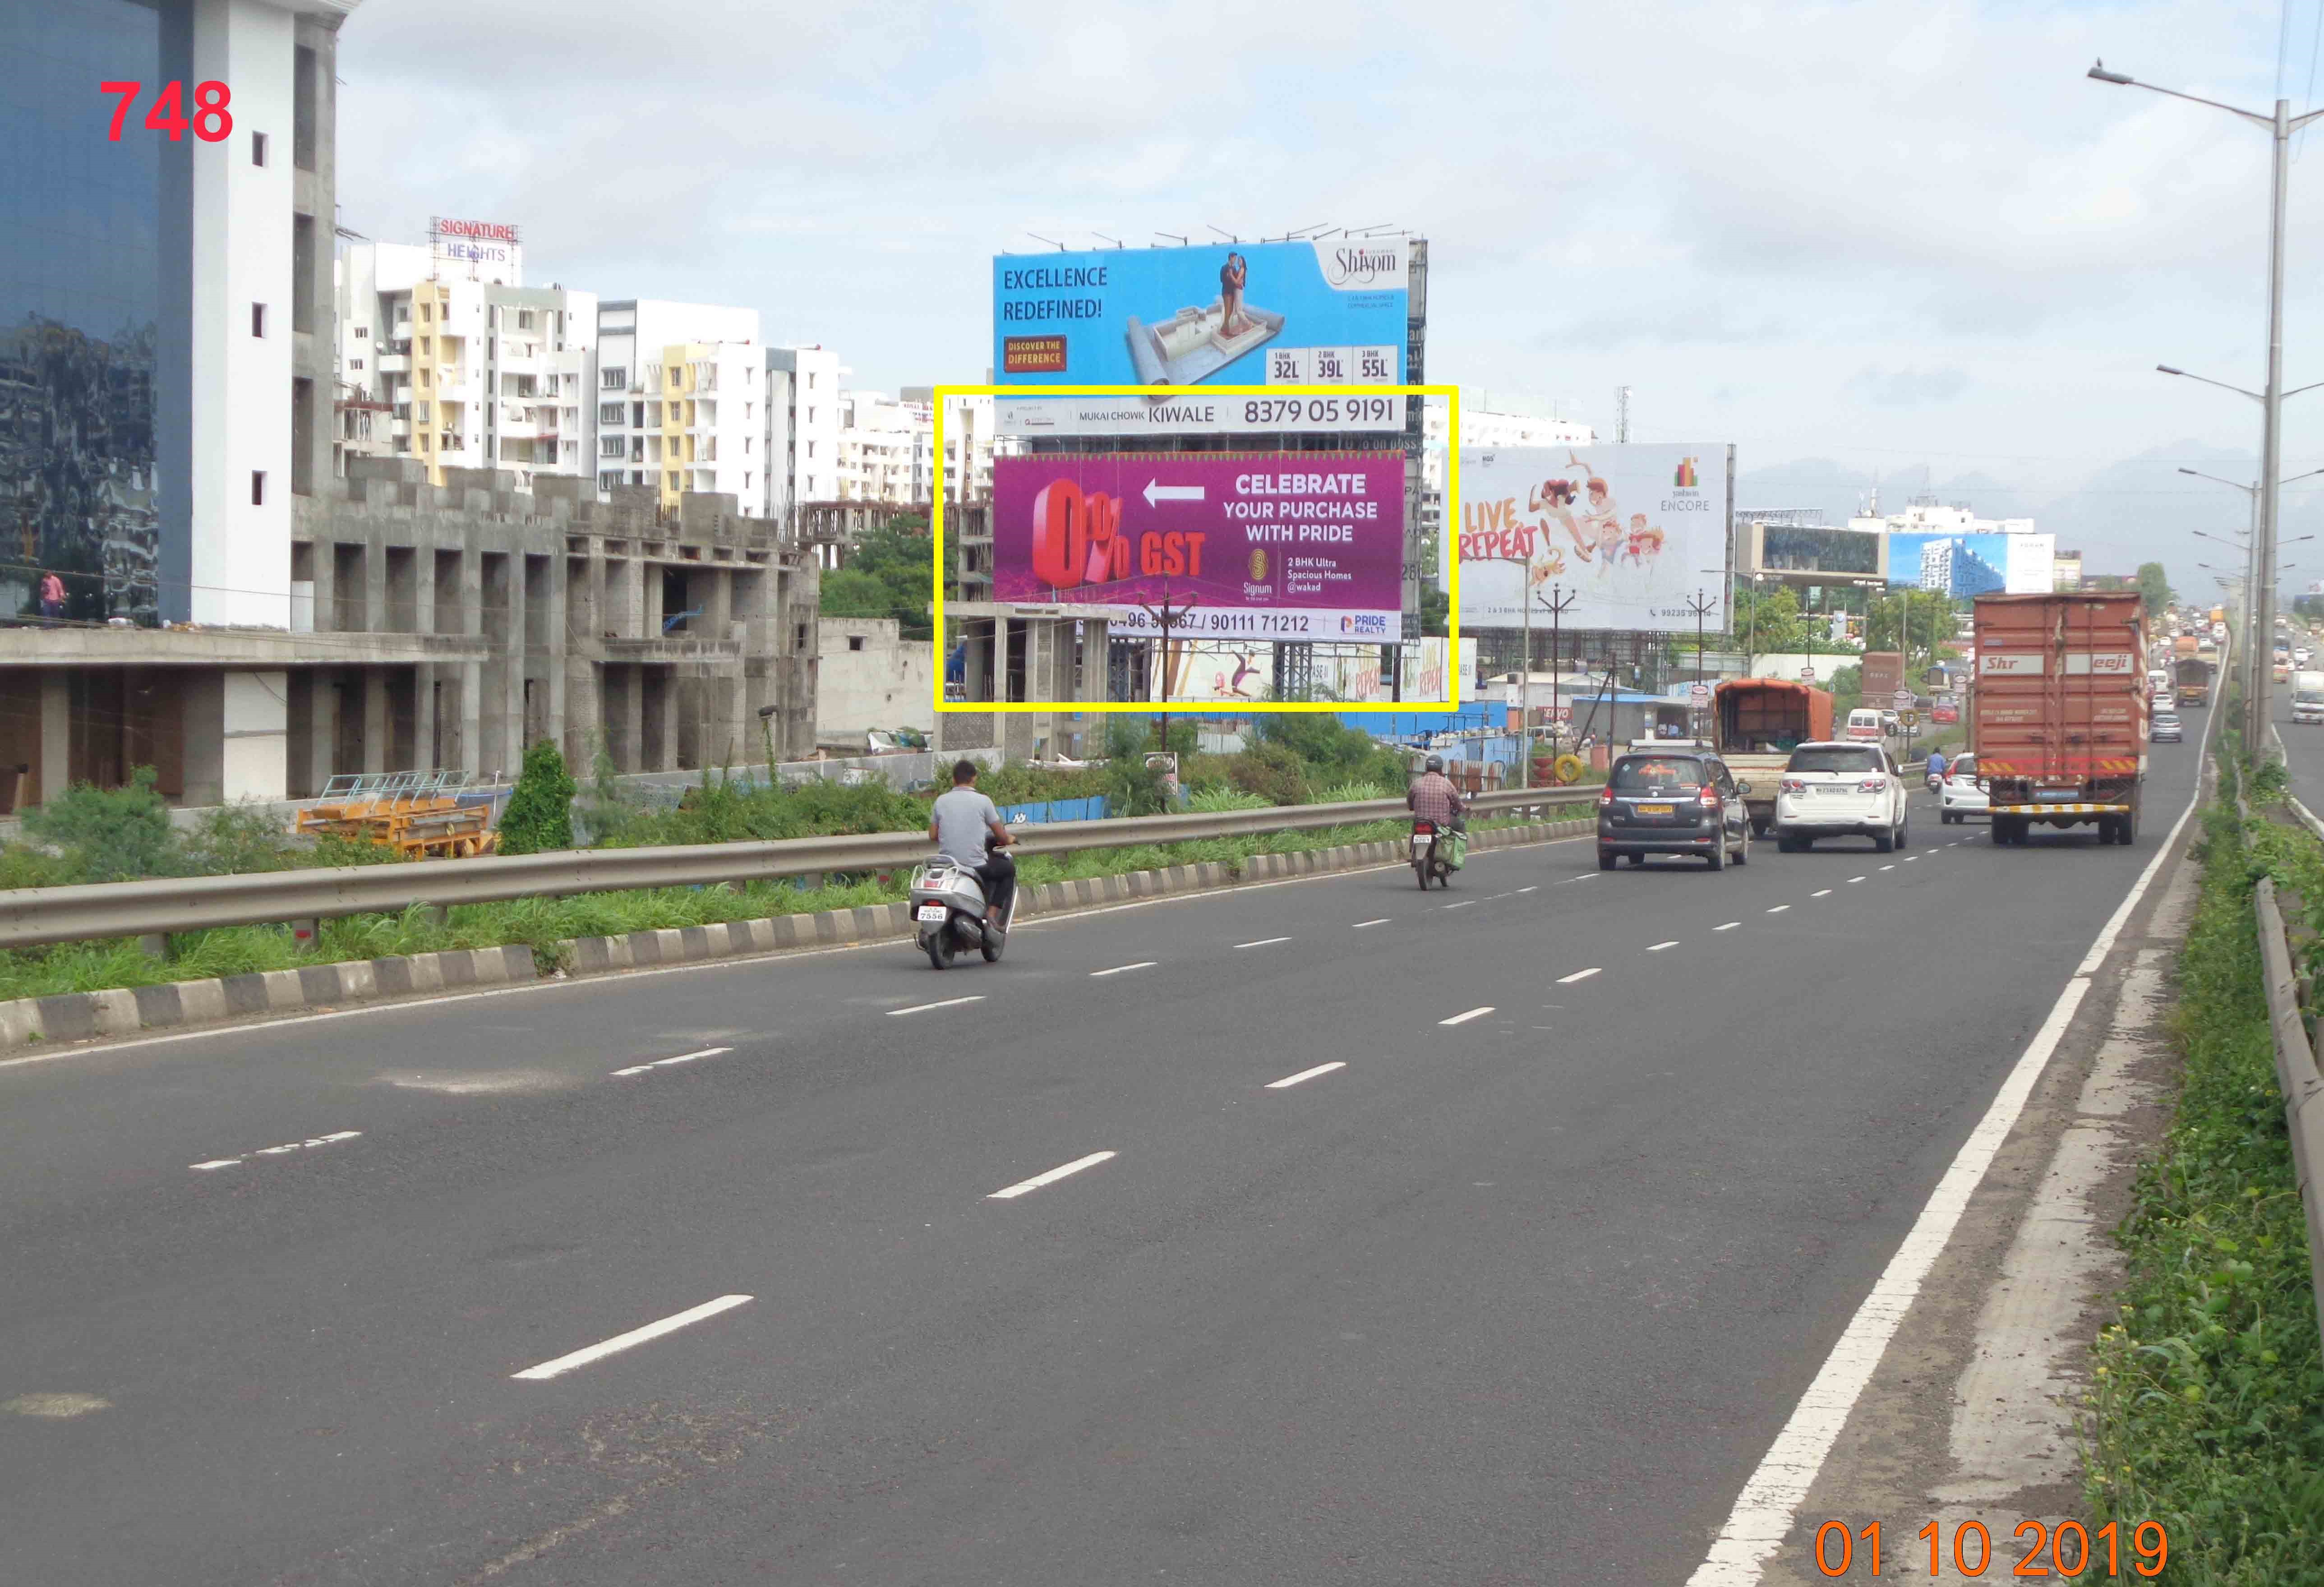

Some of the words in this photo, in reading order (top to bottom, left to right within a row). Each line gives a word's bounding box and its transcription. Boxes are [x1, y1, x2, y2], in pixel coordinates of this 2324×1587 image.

[440, 220, 513, 239] SIGNATURE
[448, 244, 505, 261] HEIGHTS
[1328, 248, 1397, 285] Shivom
[1004, 267, 1107, 289] EXCELLENCE
[1004, 299, 1102, 321] REDEFINED!
[1008, 341, 1044, 351] DISCOVER
[1047, 341, 1061, 349] THE
[1008, 353, 1061, 364] DIFFERENCE
[1079, 411, 1109, 420] MUKAI
[1111, 411, 1145, 420] CHOWK
[1149, 406, 1214, 422] KIWALE
[1245, 400, 1301, 423] 8379
[1309, 400, 1338, 422] 05
[1346, 399, 1393, 421] 9191
[1236, 473, 1366, 494] CELEBRATE
[1223, 502, 1274, 518] YOUR
[1280, 502, 1378, 518] PURCHASE
[1661, 500, 1710, 511] ENCORE
[1032, 478, 1130, 589] 0%
[1140, 531, 1205, 576] GST
[1246, 525, 1293, 541] WITH
[1299, 525, 1353, 541] PRIDE
[1459, 526, 1538, 564] REPEAT
[1288, 558, 1293, 566] 2
[1296, 558, 1314, 567] BHK
[1316, 558, 1337, 567] Ultra
[1288, 570, 1322, 580] Spacious
[1324, 571, 1351, 580] Homes
[1244, 582, 1272, 595] Signum
[1287, 582, 1321, 593] @wakad
[1211, 614, 1254, 631] 90111
[1262, 615, 1308, 632] 71212
[1355, 615, 1386, 626] PRIDE
[1987, 657, 2018, 669] Shr
[2093, 655, 2127, 671] eeji
